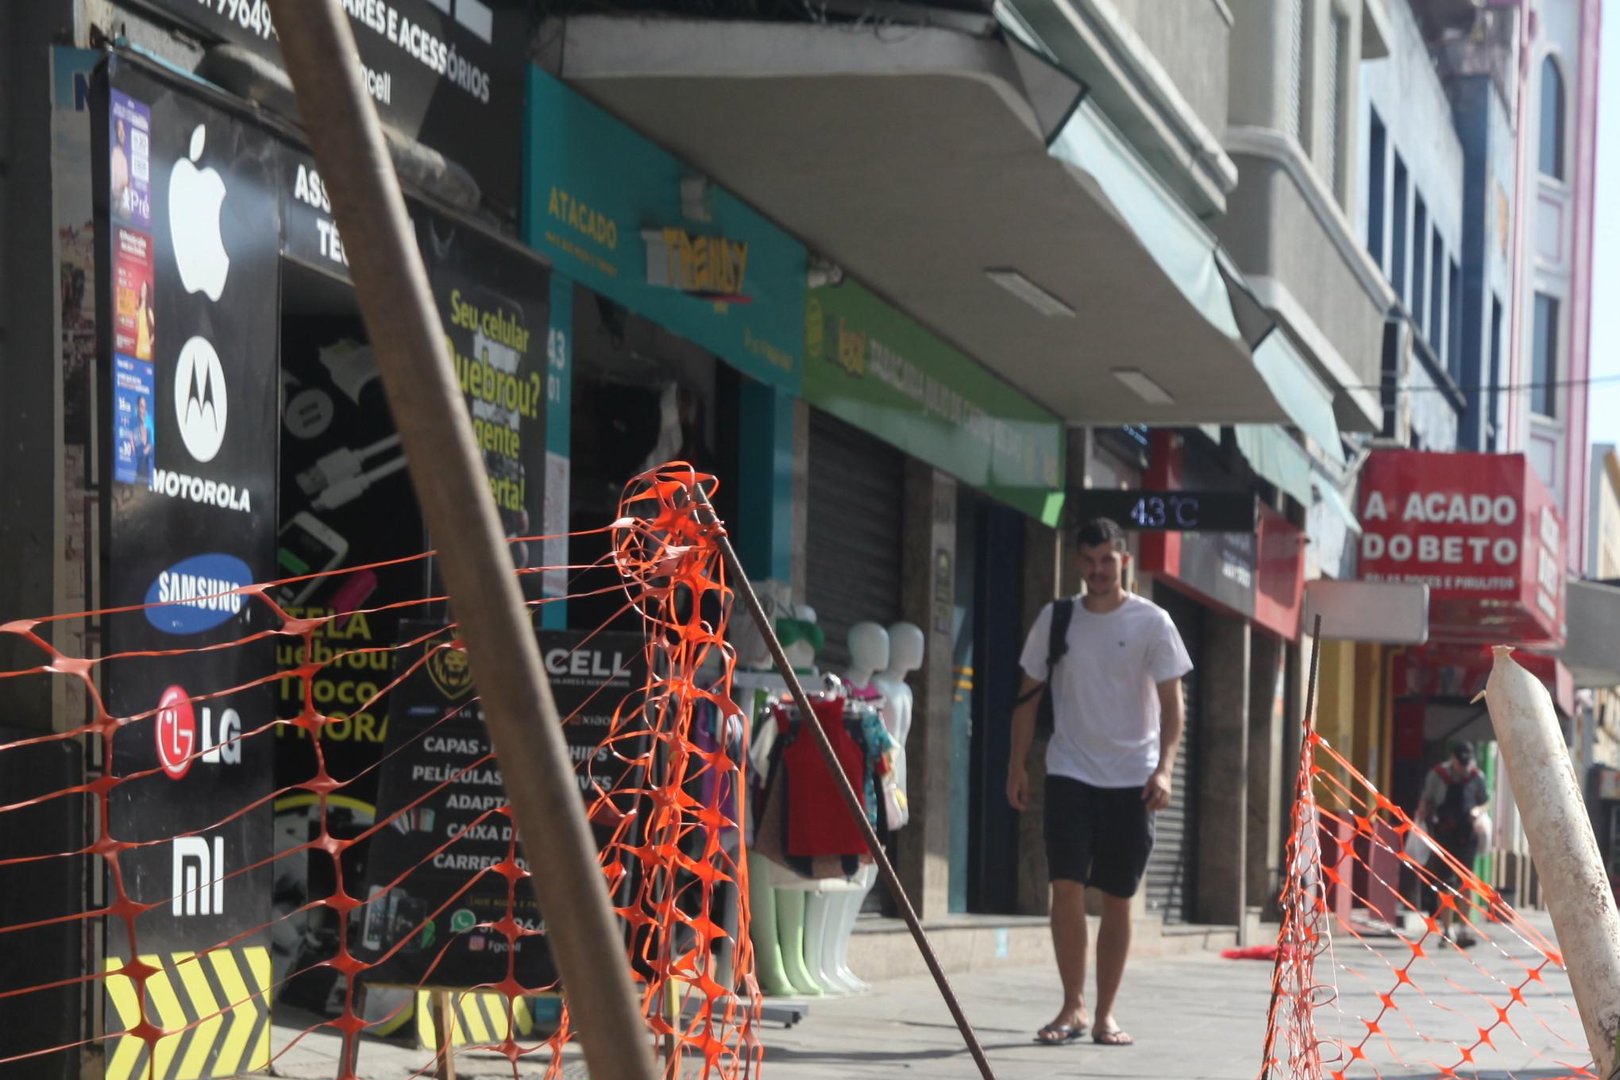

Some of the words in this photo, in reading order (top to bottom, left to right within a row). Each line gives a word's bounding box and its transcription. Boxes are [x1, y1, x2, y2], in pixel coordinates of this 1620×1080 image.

[387, 7, 399, 44] E
[399, 17, 490, 104] ACESSÓRIOS
[548, 185, 618, 251] ATACADO
[452, 288, 479, 331] Seu
[482, 306, 530, 353] celular
[152, 468, 251, 513] MOTOROLA
[158, 569, 242, 615] SAMSUNG
[201, 706, 242, 766] LG
[423, 736, 479, 756] CAPAS
[412, 763, 503, 787] PELÍCULAS
[447, 823, 499, 841] CAIXA
